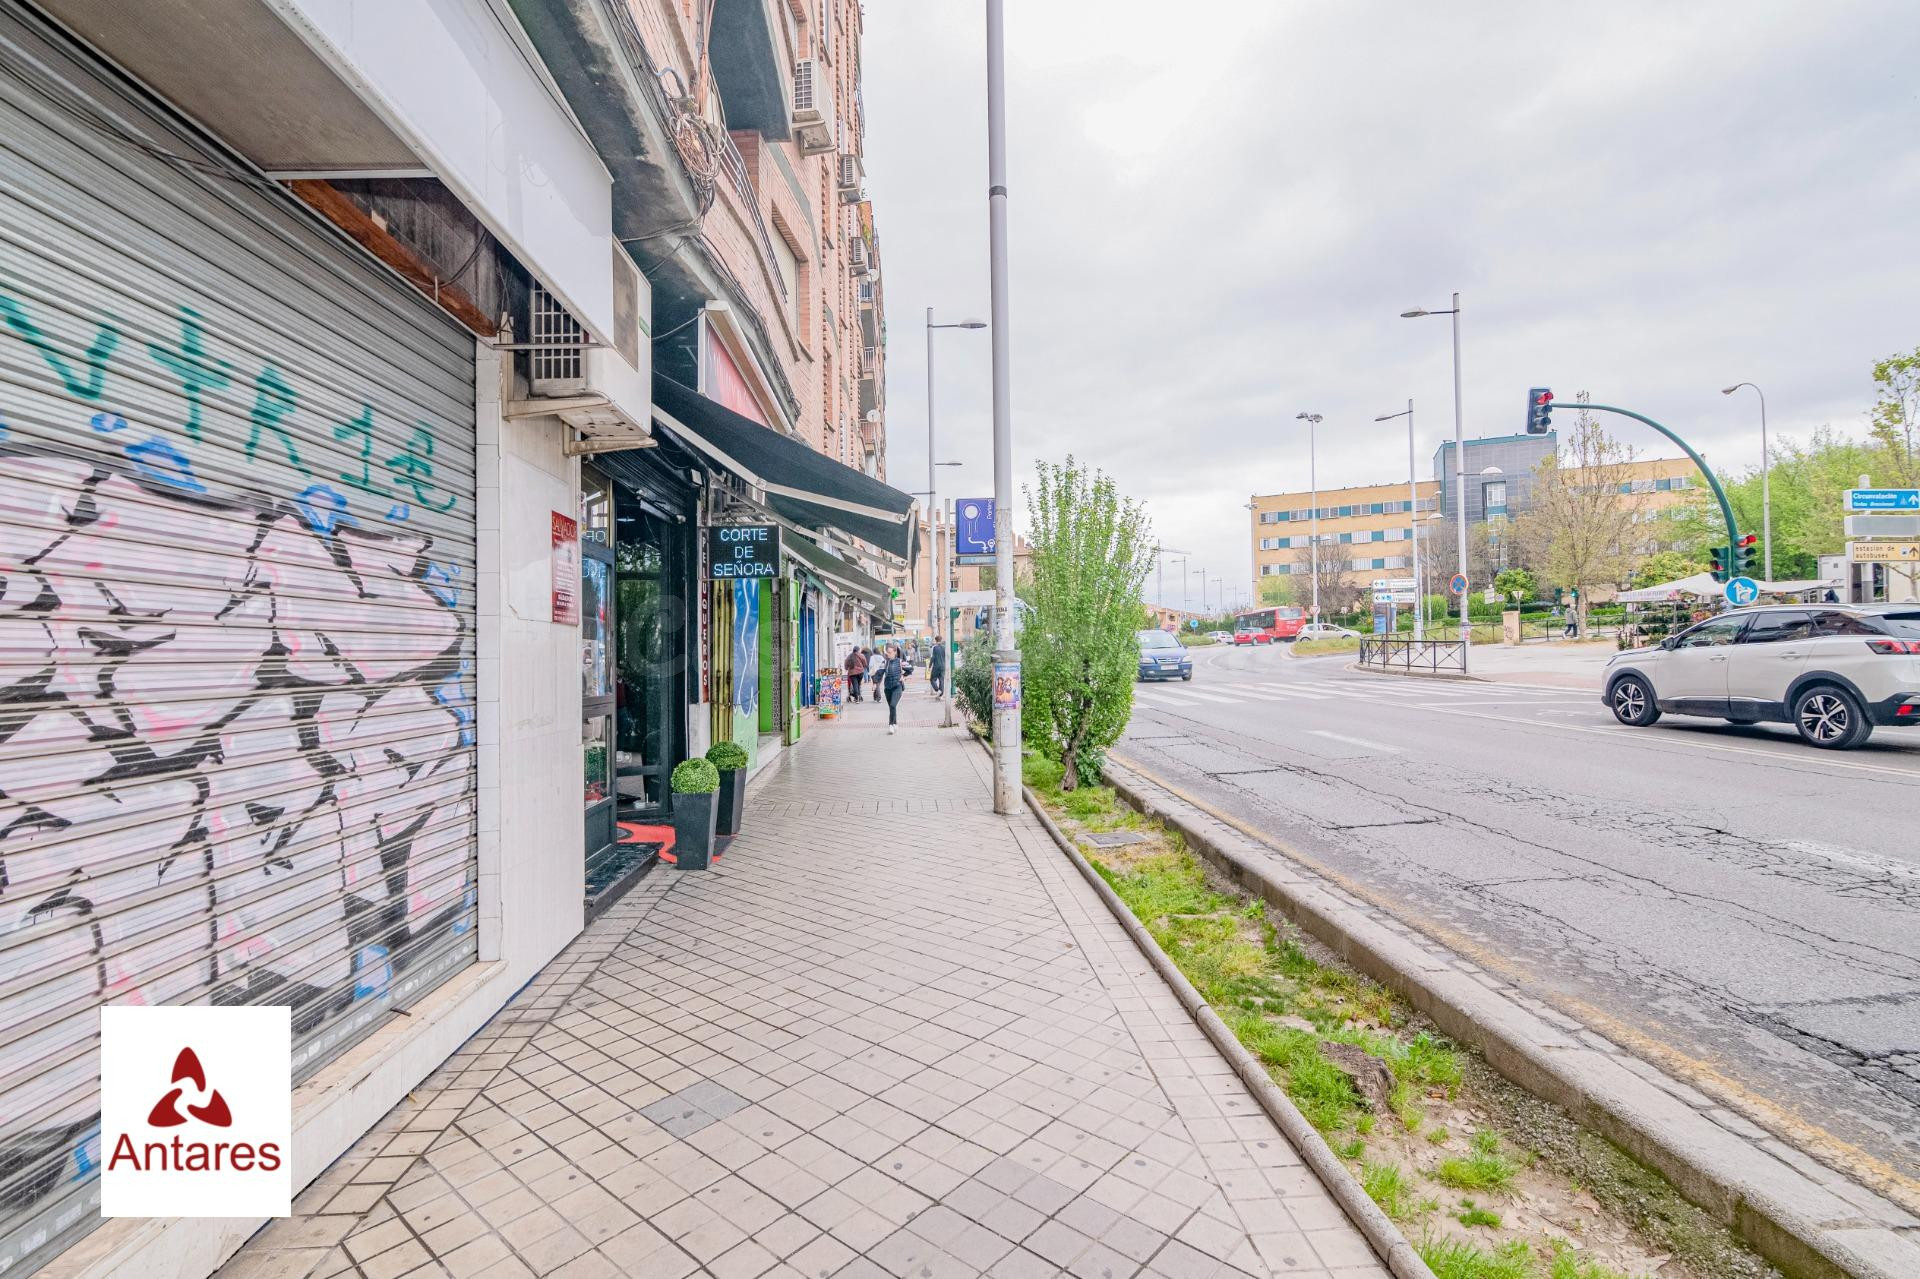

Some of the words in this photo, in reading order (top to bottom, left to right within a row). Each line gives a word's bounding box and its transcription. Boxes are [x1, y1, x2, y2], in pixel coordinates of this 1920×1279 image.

[720, 527, 768, 542] CORTE
[734, 545, 755, 559] DE
[713, 560, 775, 577] SEÑORA
